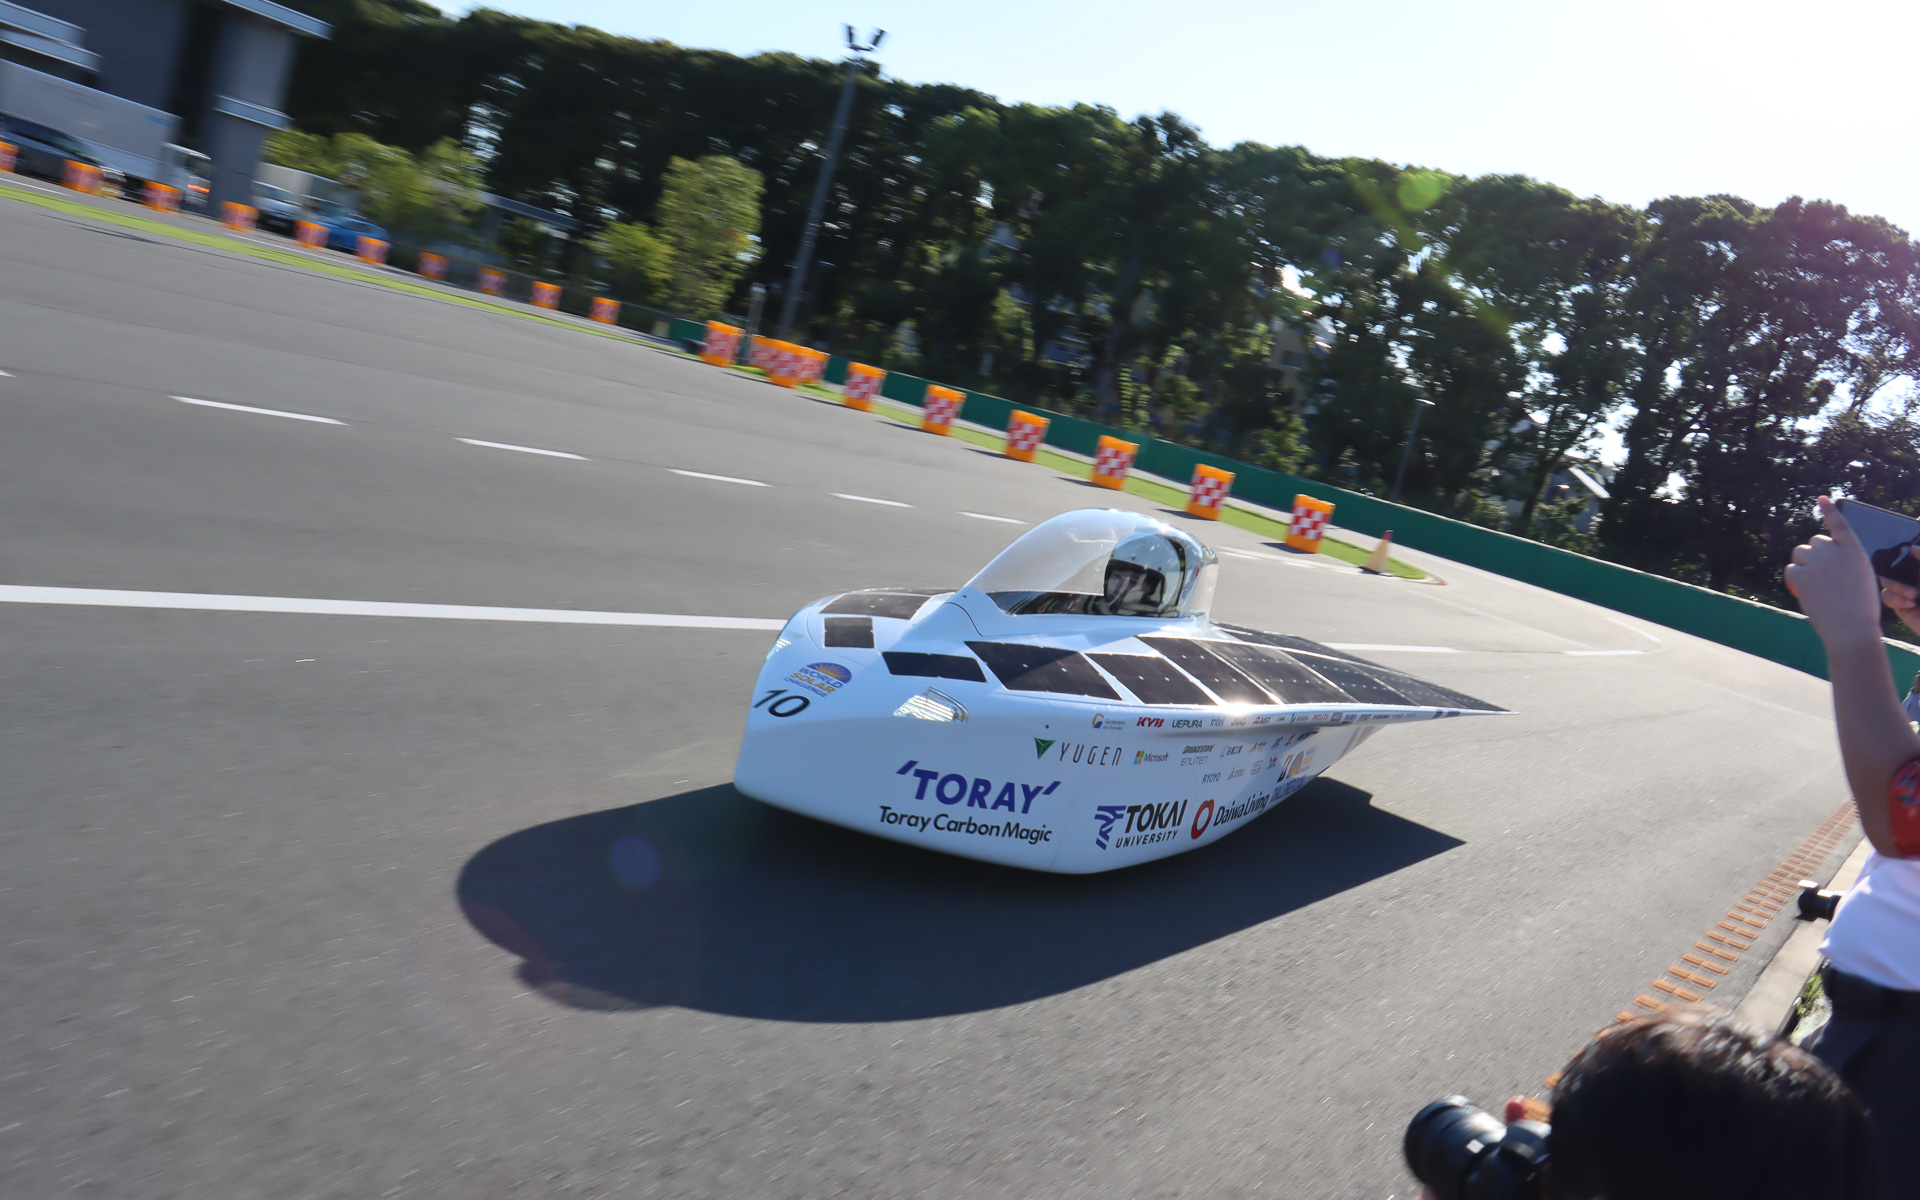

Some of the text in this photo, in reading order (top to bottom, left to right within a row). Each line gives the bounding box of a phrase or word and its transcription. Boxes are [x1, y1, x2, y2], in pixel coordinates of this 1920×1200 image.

[789, 672, 836, 694] SOLAR
[798, 667, 843, 689] WORLD
[753, 689, 810, 718] 10
[1136, 716, 1165, 728] KYB
[1171, 719, 1203, 729] UEPURA
[1059, 742, 1123, 766] YUGEN
[1144, 751, 1169, 763] Microsoft
[1125, 799, 1188, 833] TOKAI
[1213, 791, 1271, 827] Daiwa Living
[879, 805, 1053, 845] Toray Carbon Magic
[1115, 829, 1179, 848] UNIVERSITY
